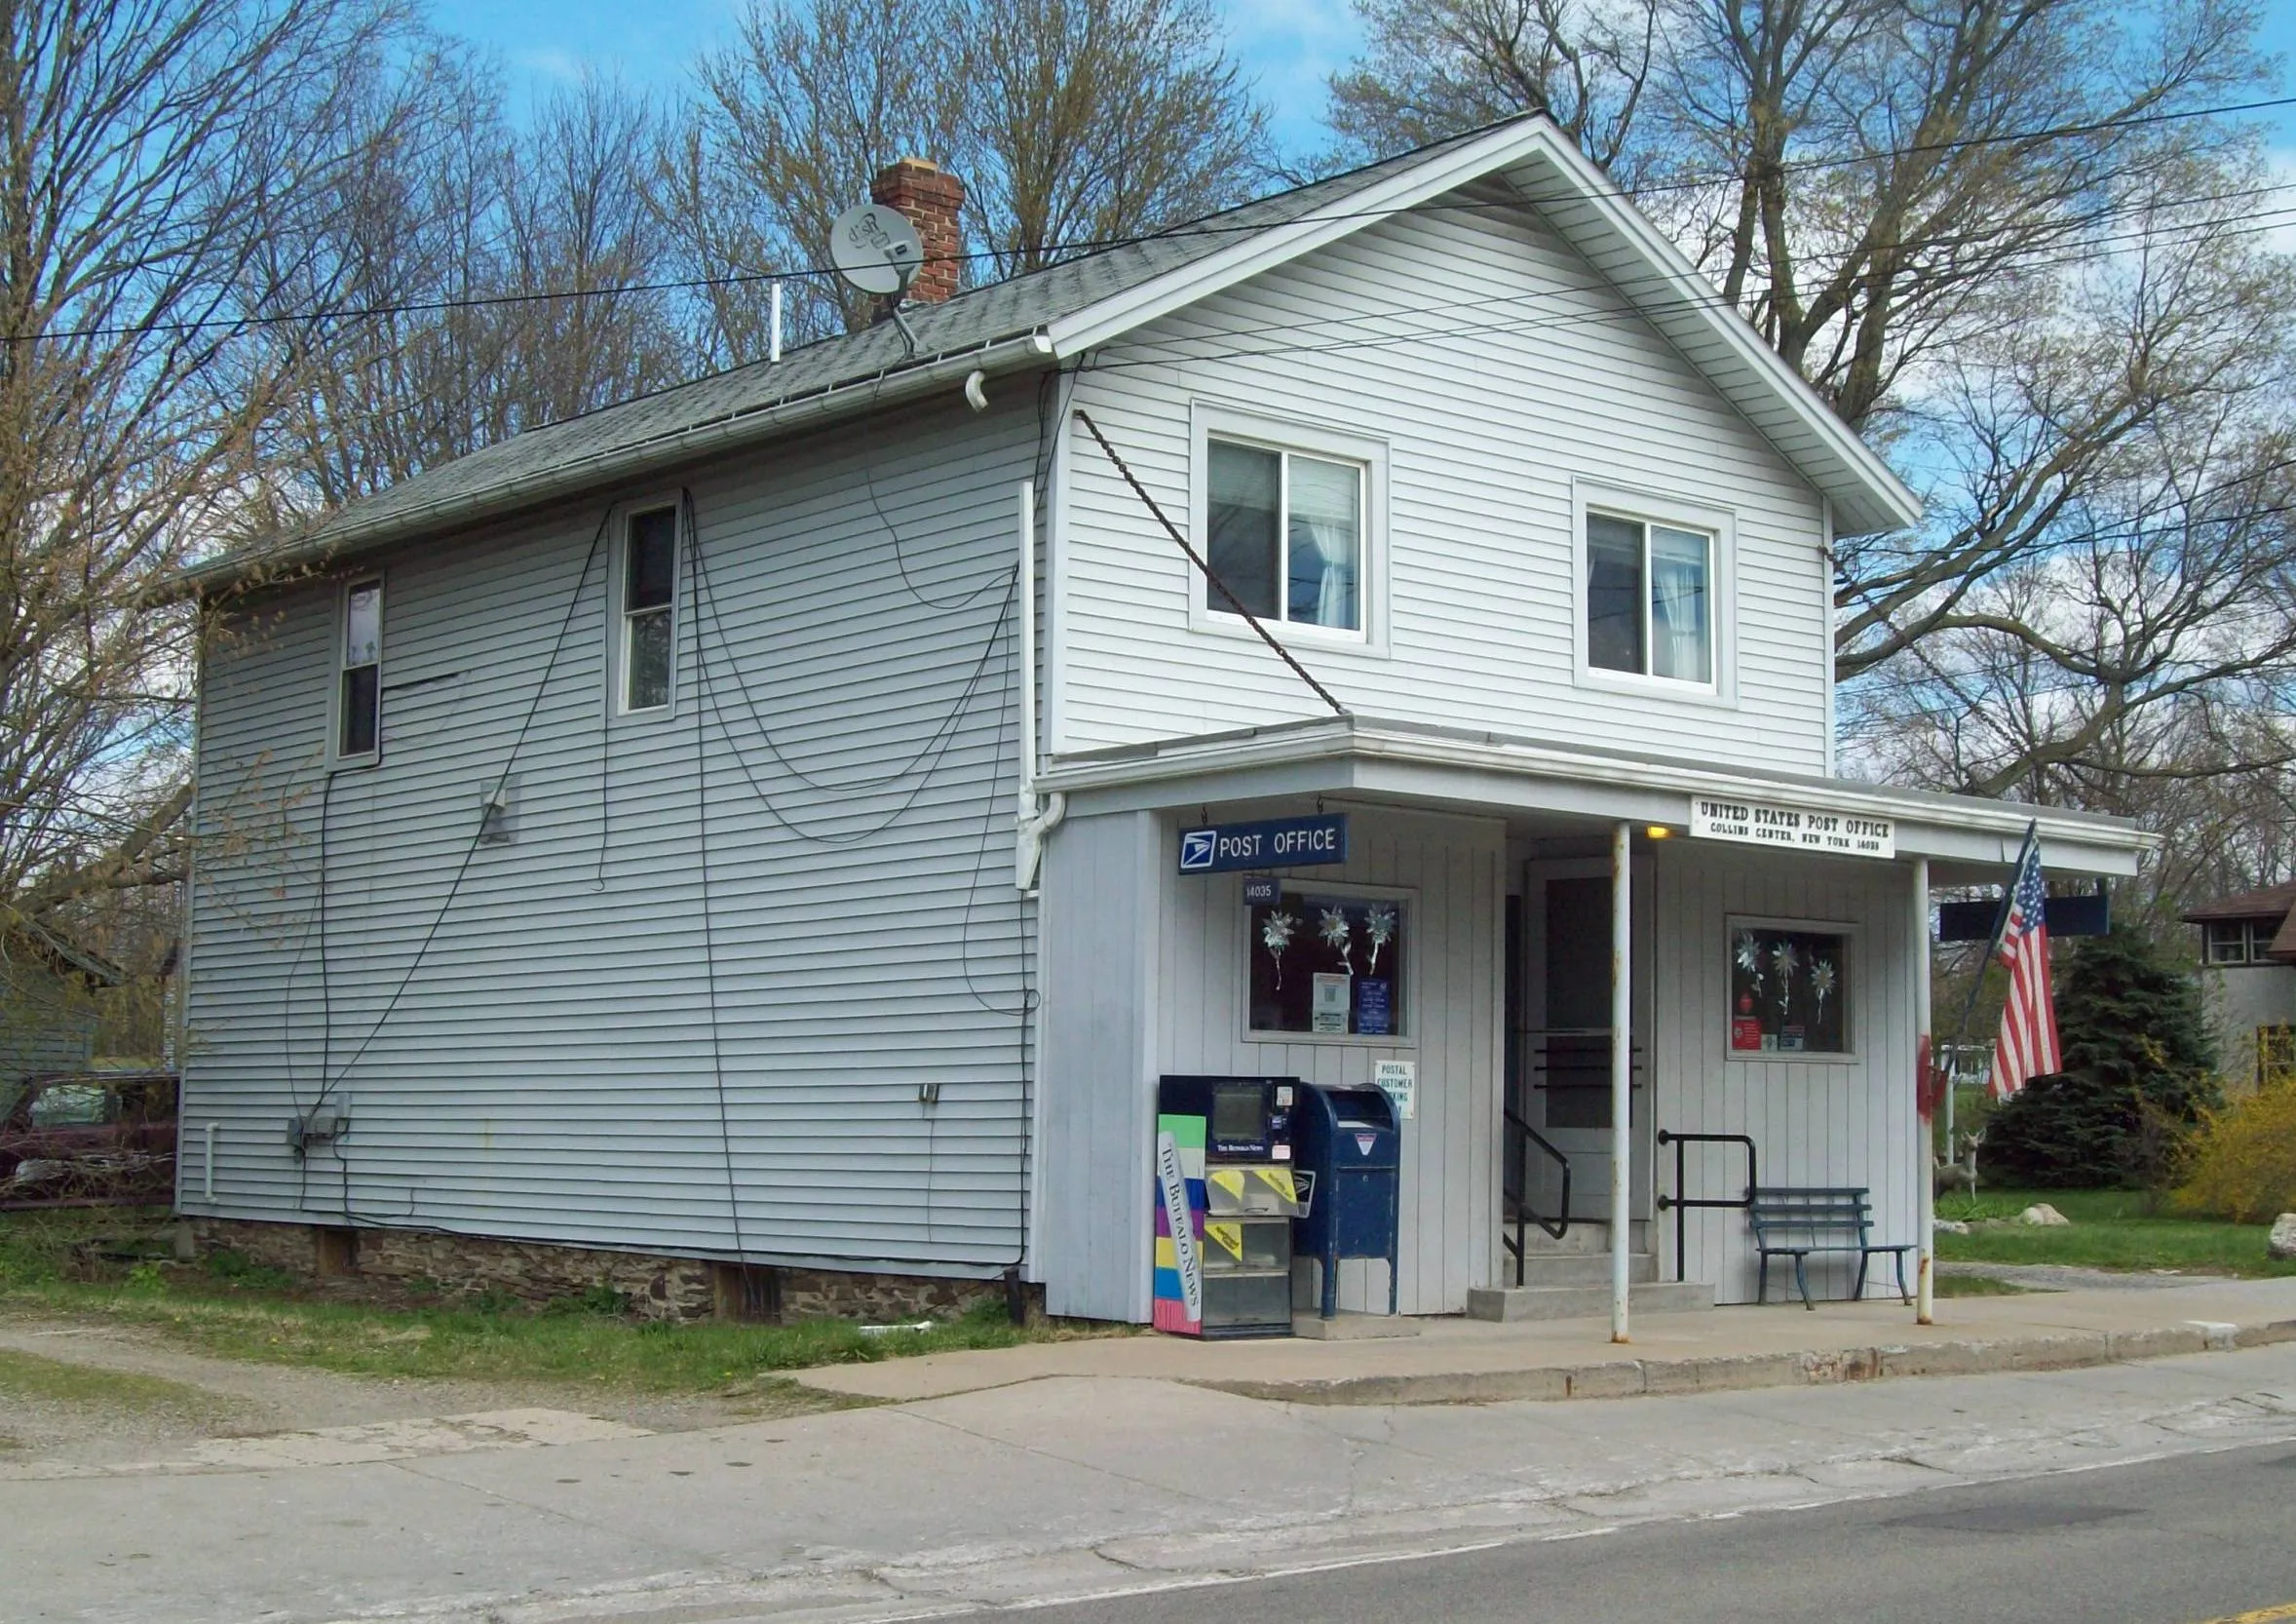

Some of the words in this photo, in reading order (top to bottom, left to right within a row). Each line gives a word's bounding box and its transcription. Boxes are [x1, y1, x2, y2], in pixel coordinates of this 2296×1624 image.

[1701, 802, 1748, 821] UNITED
[1754, 808, 1800, 828] STATES
[1808, 815, 1838, 832] POST
[1847, 819, 1889, 838] OFFICE
[1219, 834, 1262, 858] POST
[1275, 828, 1336, 855] OFFICE
[1710, 822, 1748, 835] COLLINS
[1802, 832, 1820, 844] NEW
[1827, 835, 1850, 848] YORK
[1246, 885, 1272, 898] 14035
[1381, 1064, 1407, 1075] POSTAL
[1377, 1078, 1413, 1089] CUSTOMER
[1162, 1147, 1174, 1179] THE
[1168, 1182, 1189, 1256] BUFFALO
[1183, 1257, 1200, 1307] NEWS
